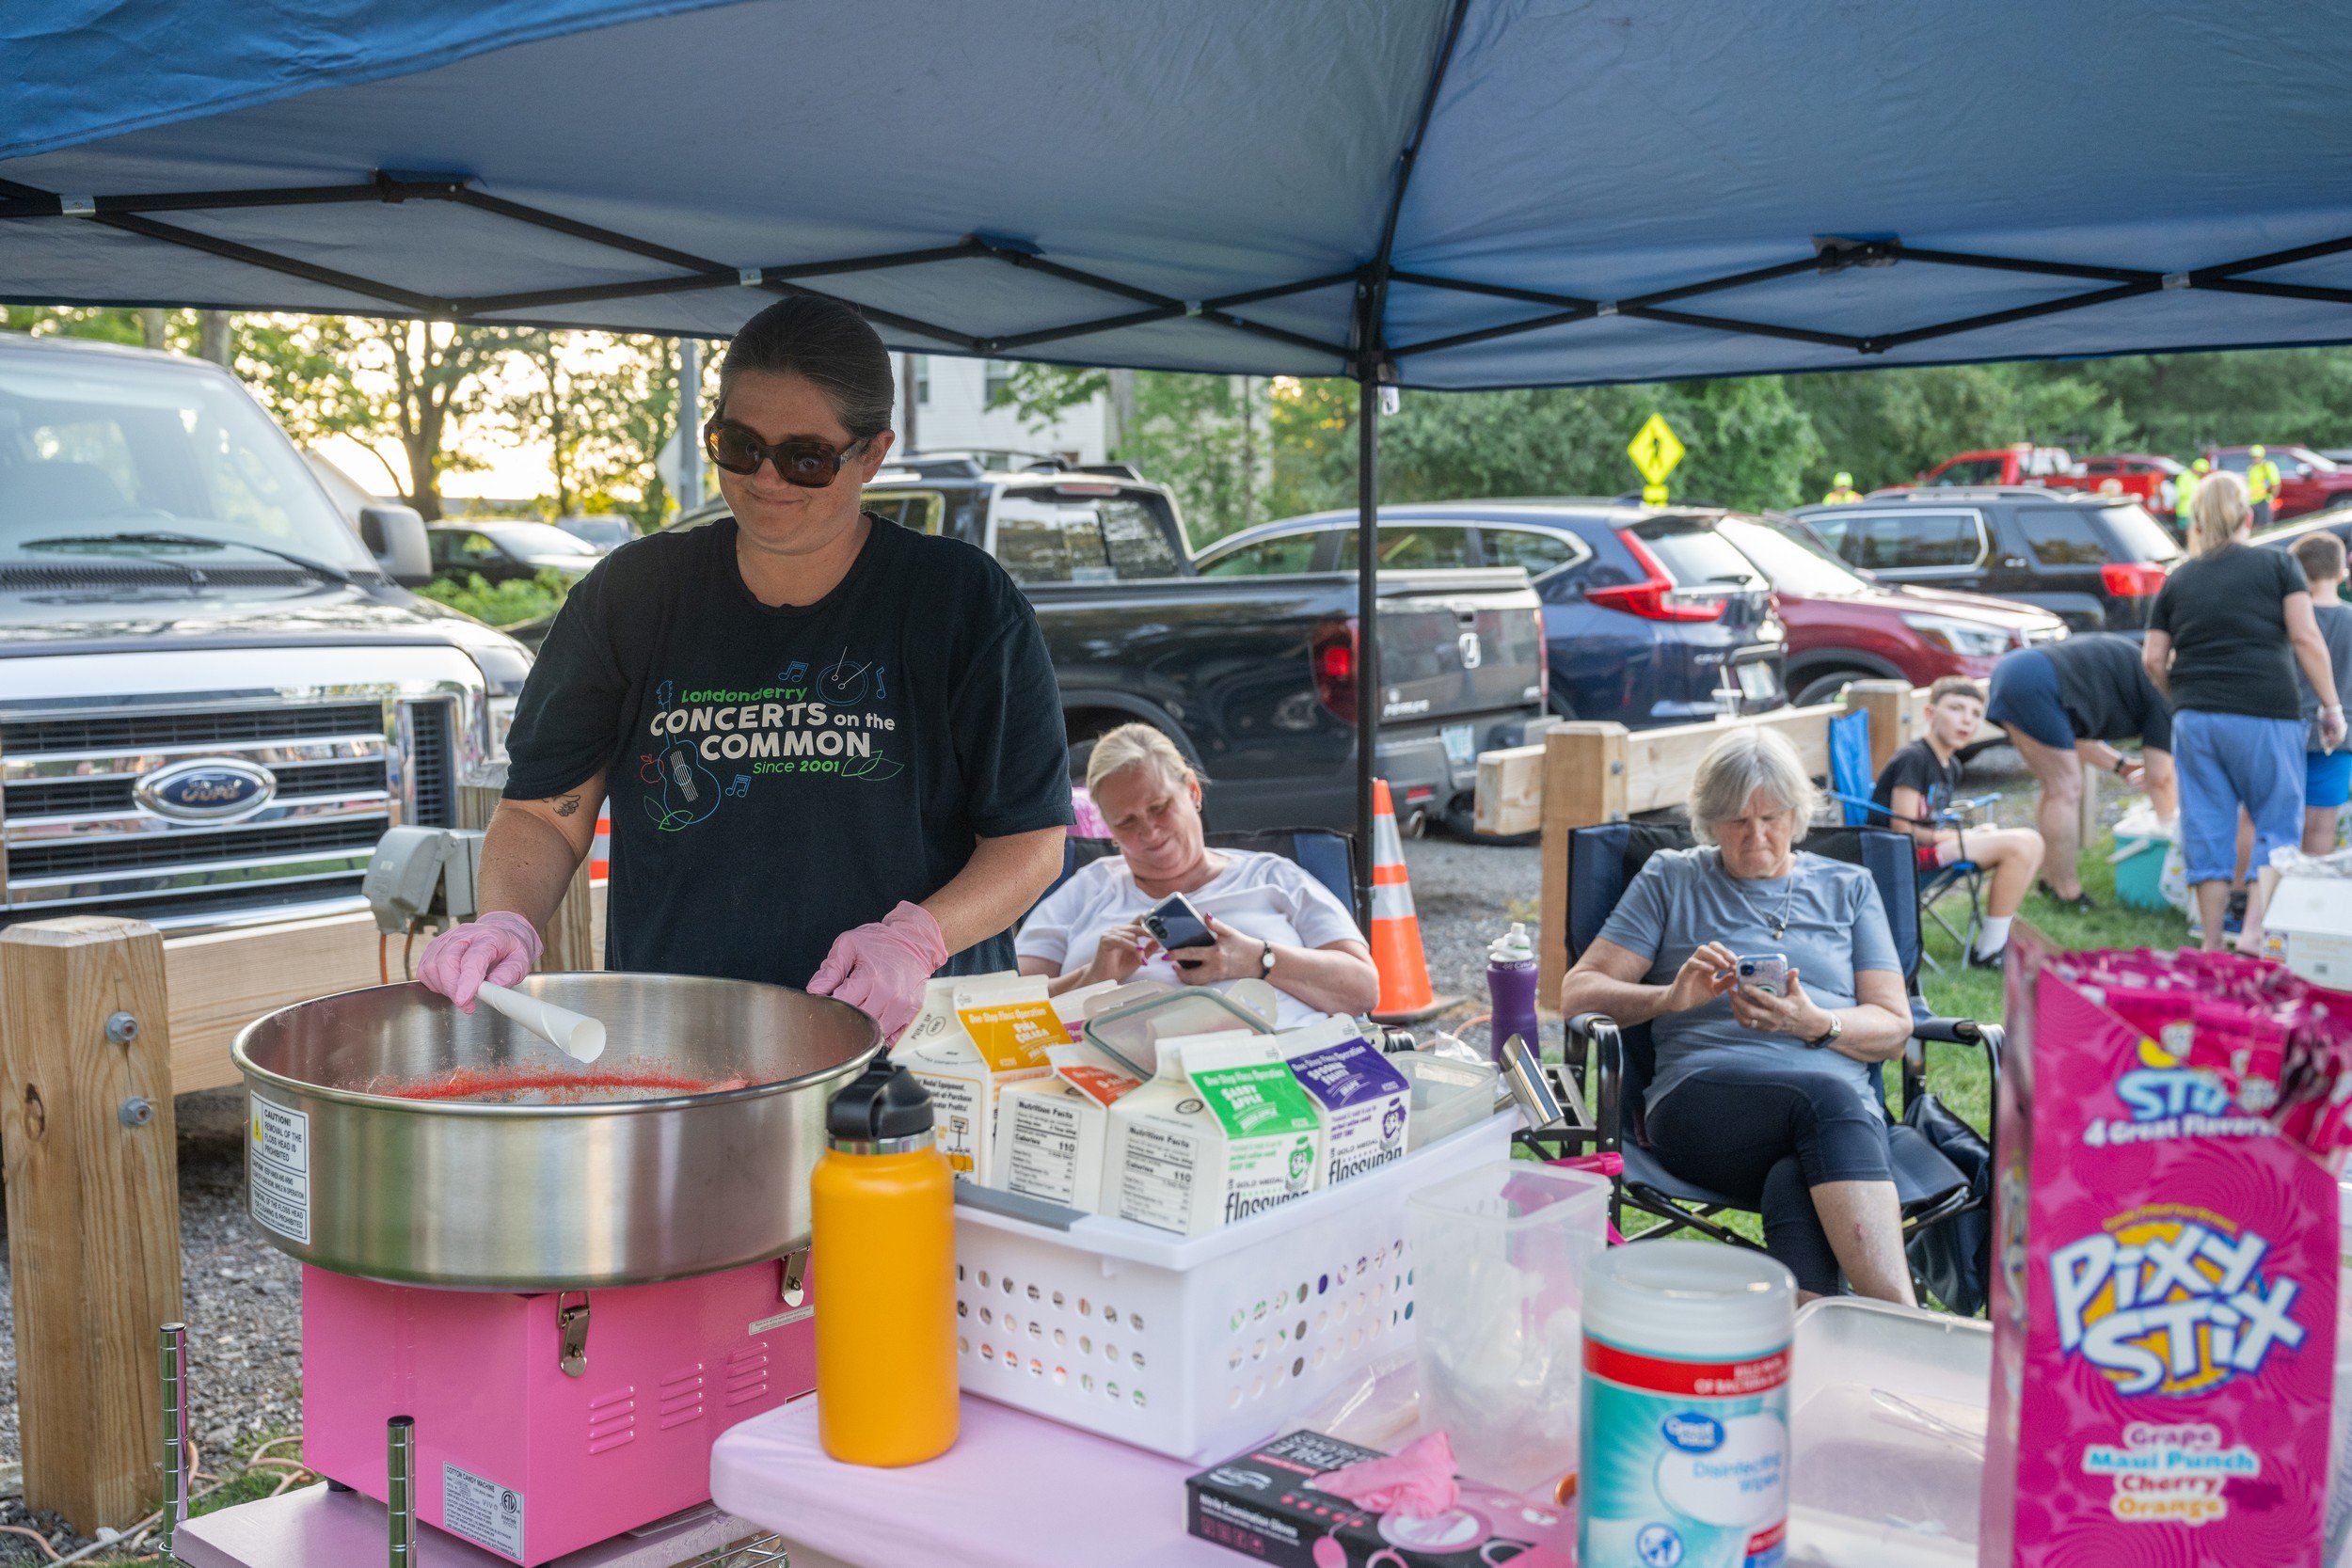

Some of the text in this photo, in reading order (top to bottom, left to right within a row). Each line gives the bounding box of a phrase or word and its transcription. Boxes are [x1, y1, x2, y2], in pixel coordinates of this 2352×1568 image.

[681, 686, 808, 704] Londonderry
[650, 702, 896, 736] CONCERTS on the
[700, 730, 871, 761] COMMON
[799, 760, 840, 773] 2001
[181, 778, 243, 802] Ford
[264, 1108, 292, 1127] CAUTION!
[1018, 1101, 1073, 1119] Nutrition Facts
[264, 1121, 303, 1143] REMOVAL OF THE
[264, 1132, 296, 1153] FLOSS HEAD IS
[2082, 1116, 2107, 1148] 4
[2107, 1117, 2179, 1145] Great
[264, 1144, 290, 1162] PROHIBITED
[1059, 1142, 1075, 1152] 110
[1174, 1171, 1192, 1182] 110
[2129, 1426, 2215, 1449] Grape
[2088, 1449, 2256, 1472] Maui Punch
[2121, 1473, 2218, 1495] Cherry
[2116, 1496, 2221, 1520] Orange
